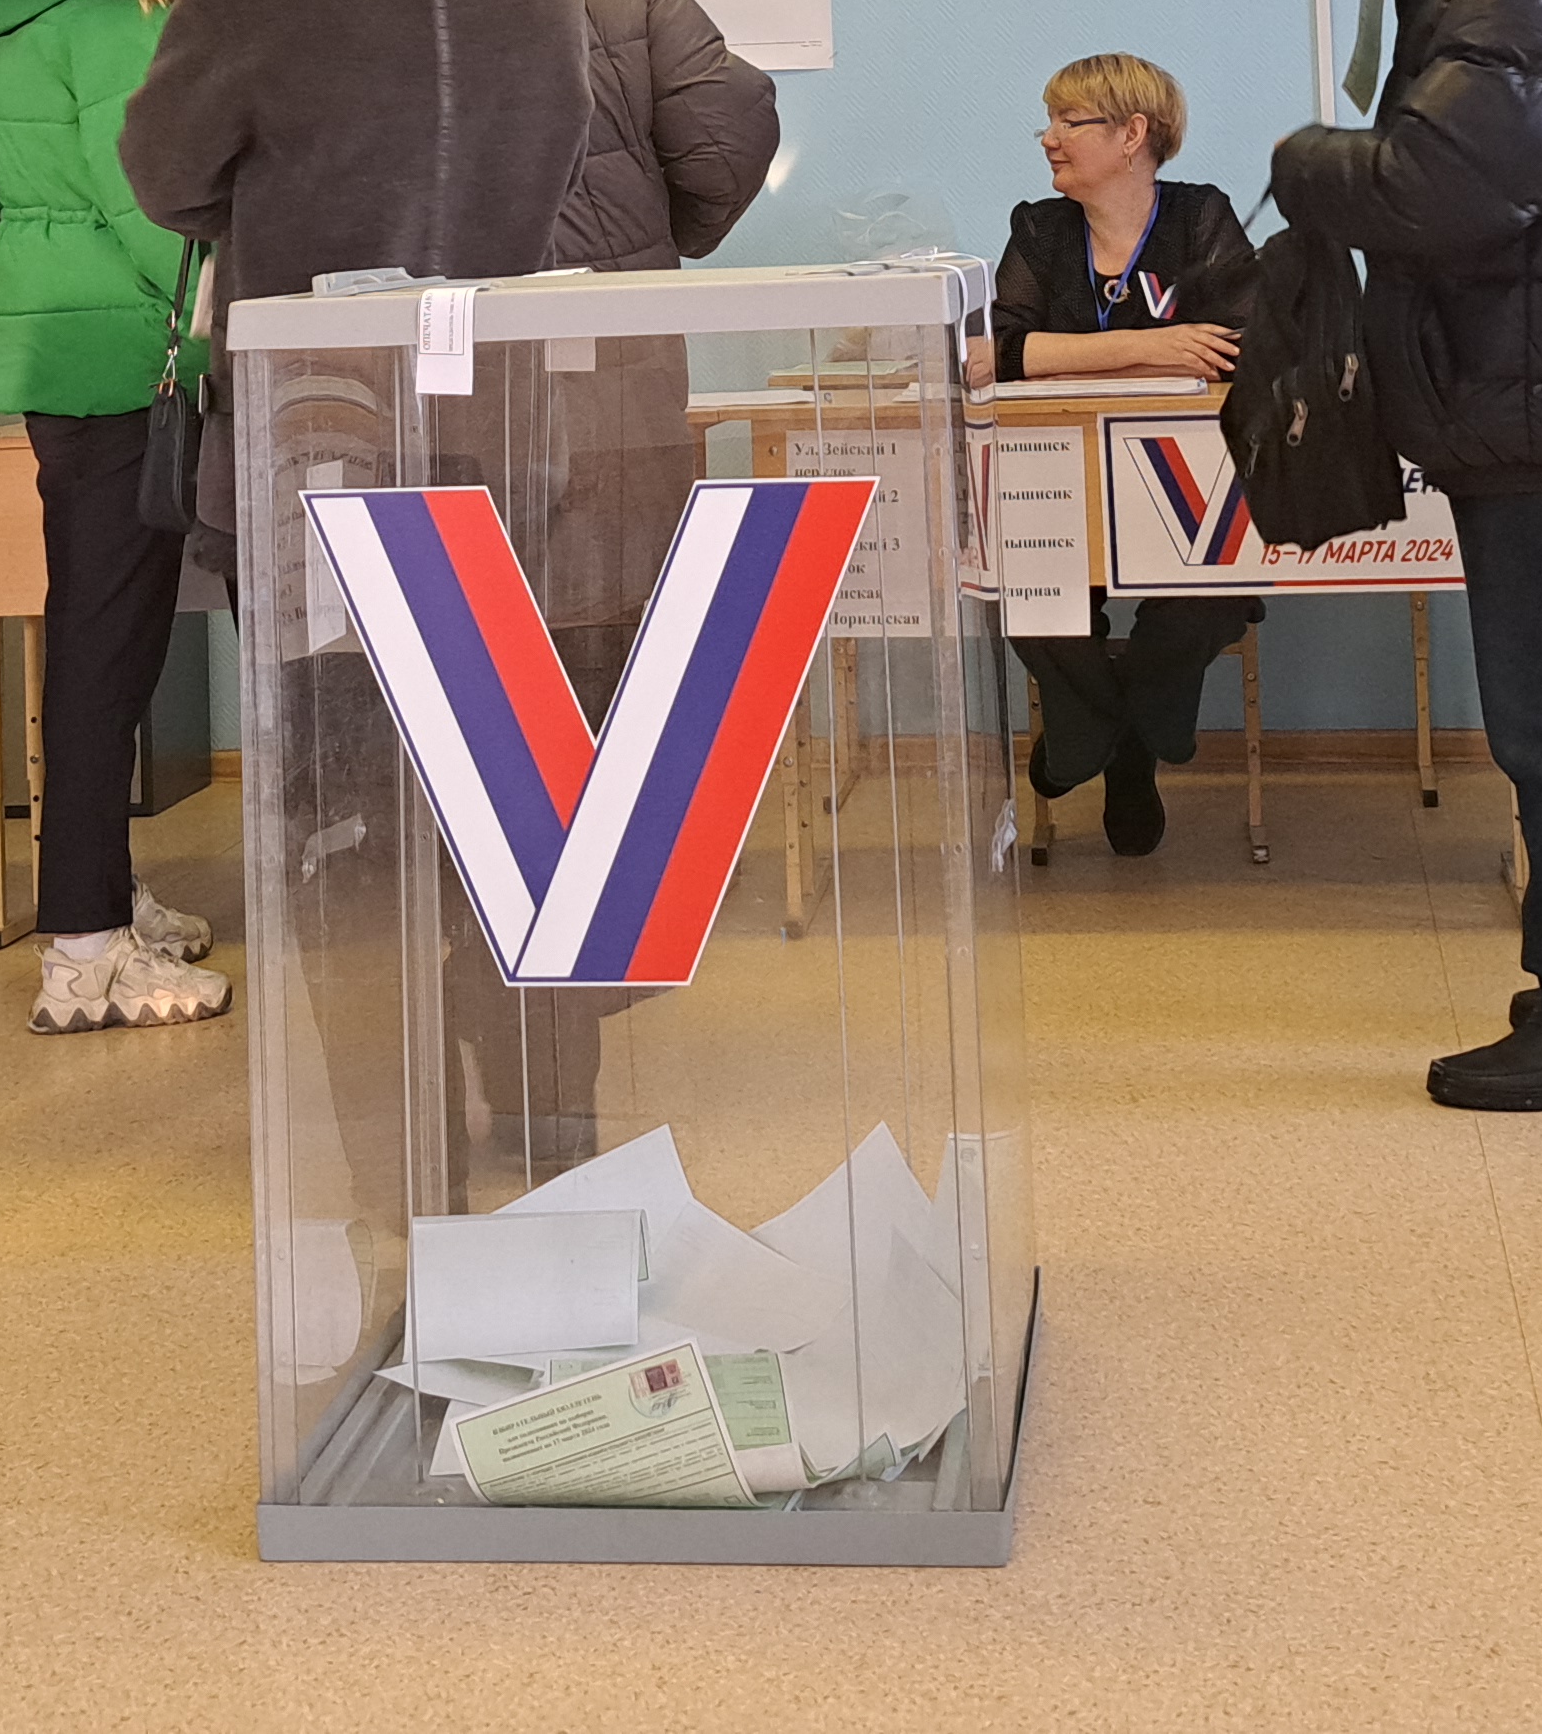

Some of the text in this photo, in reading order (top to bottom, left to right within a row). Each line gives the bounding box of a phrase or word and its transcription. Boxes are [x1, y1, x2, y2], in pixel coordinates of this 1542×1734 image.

[892, 538, 900, 551] 3
[1322, 540, 1397, 565] МАРТА
[1401, 538, 1454, 563] 2024
[1006, 585, 1061, 601] лярная
